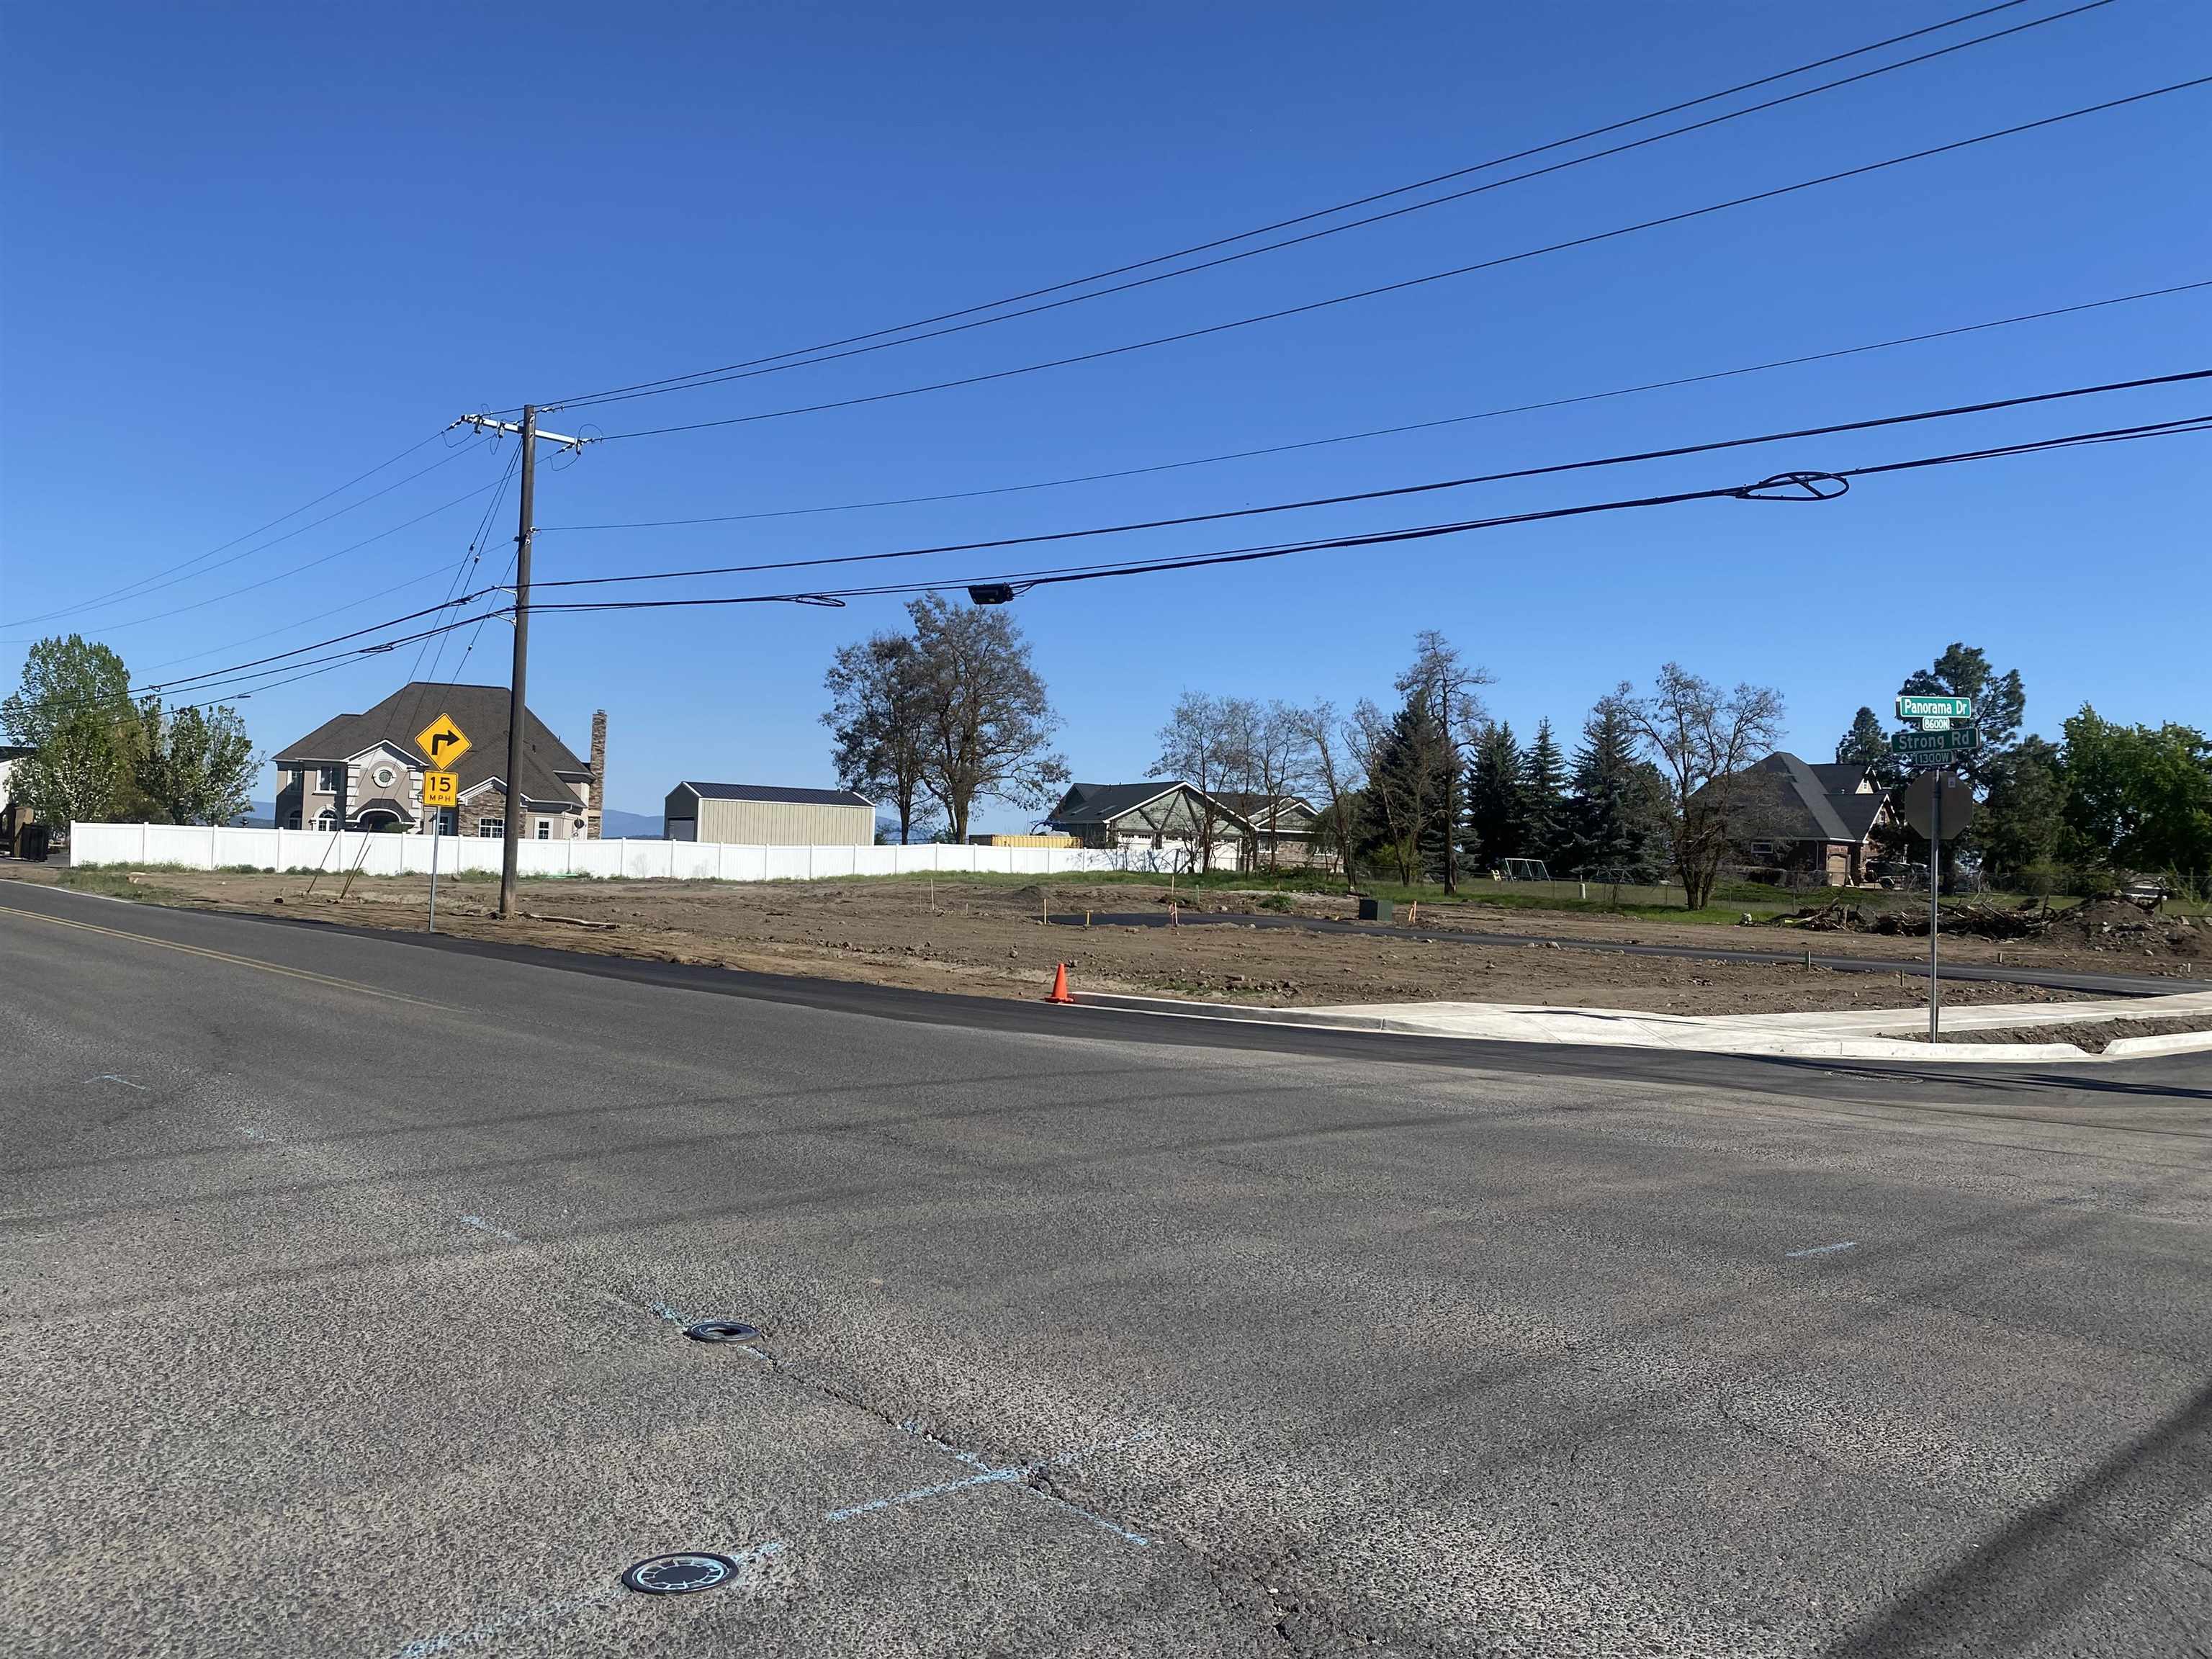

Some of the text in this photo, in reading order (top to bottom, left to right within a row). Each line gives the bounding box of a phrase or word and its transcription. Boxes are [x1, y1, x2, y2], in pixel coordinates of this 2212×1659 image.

[1905, 698, 1967, 714] Panorama Dr
[1924, 719, 1948, 729] 8600N
[1899, 732, 1969, 750] Strong Rd
[1919, 752, 1950, 763] 1300W
[431, 776, 451, 792] 15
